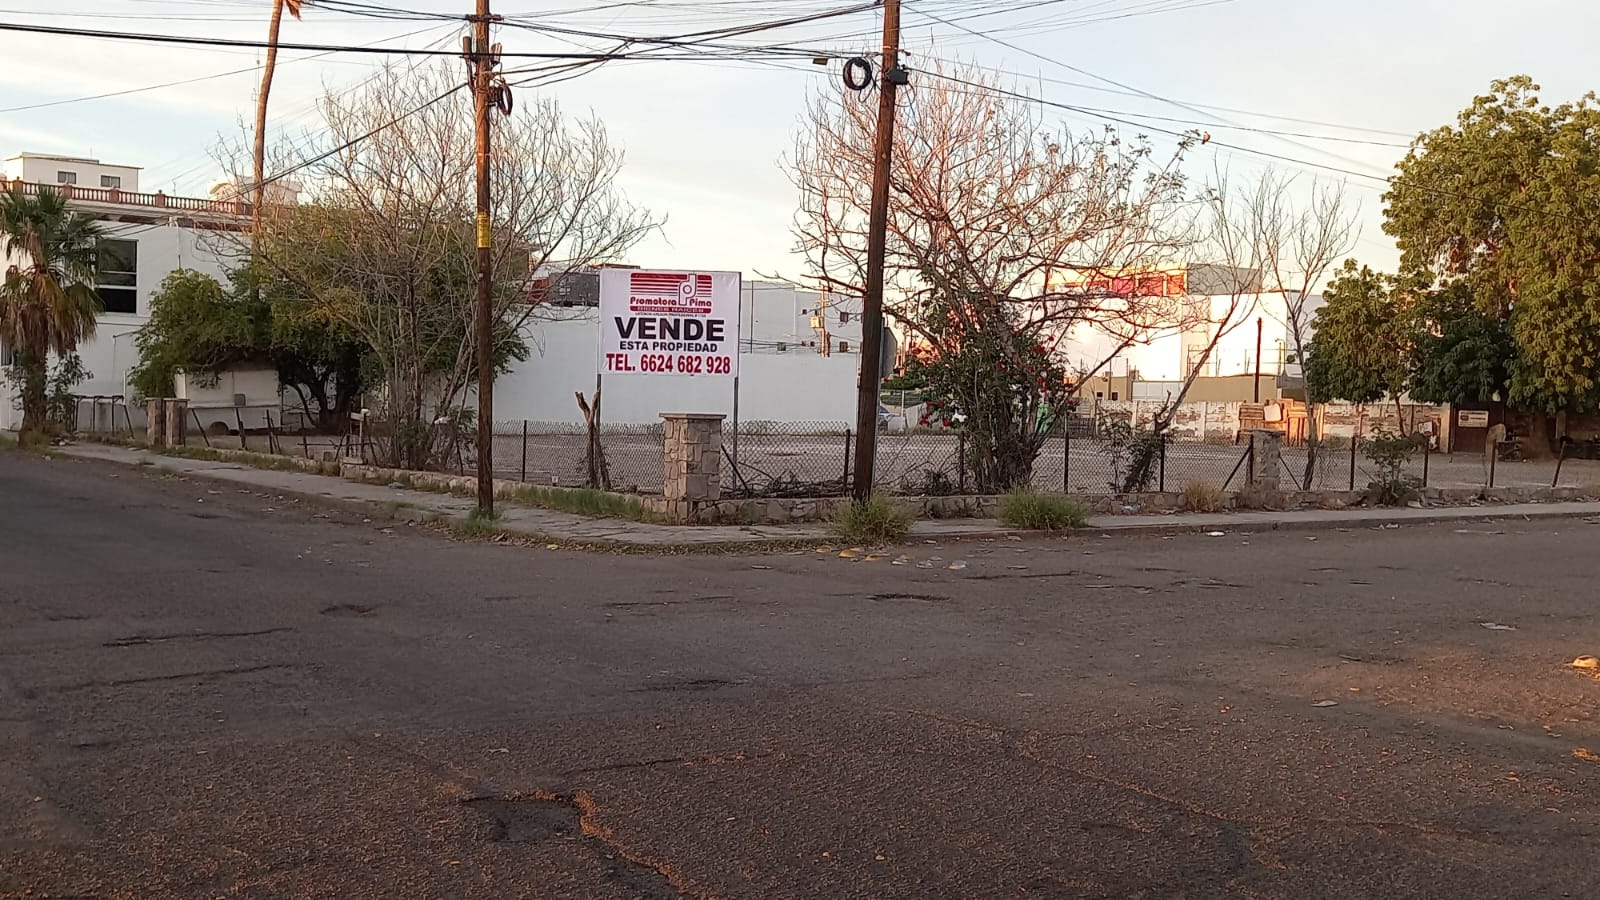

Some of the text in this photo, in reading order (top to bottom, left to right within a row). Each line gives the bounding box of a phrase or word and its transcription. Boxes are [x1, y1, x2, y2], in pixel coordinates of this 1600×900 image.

[630, 296, 712, 307] Promotora Pima
[614, 316, 725, 342] VENDE
[619, 340, 718, 353] ESTA PROPIEDAD
[606, 353, 731, 374] TEL. 6624 682 928
